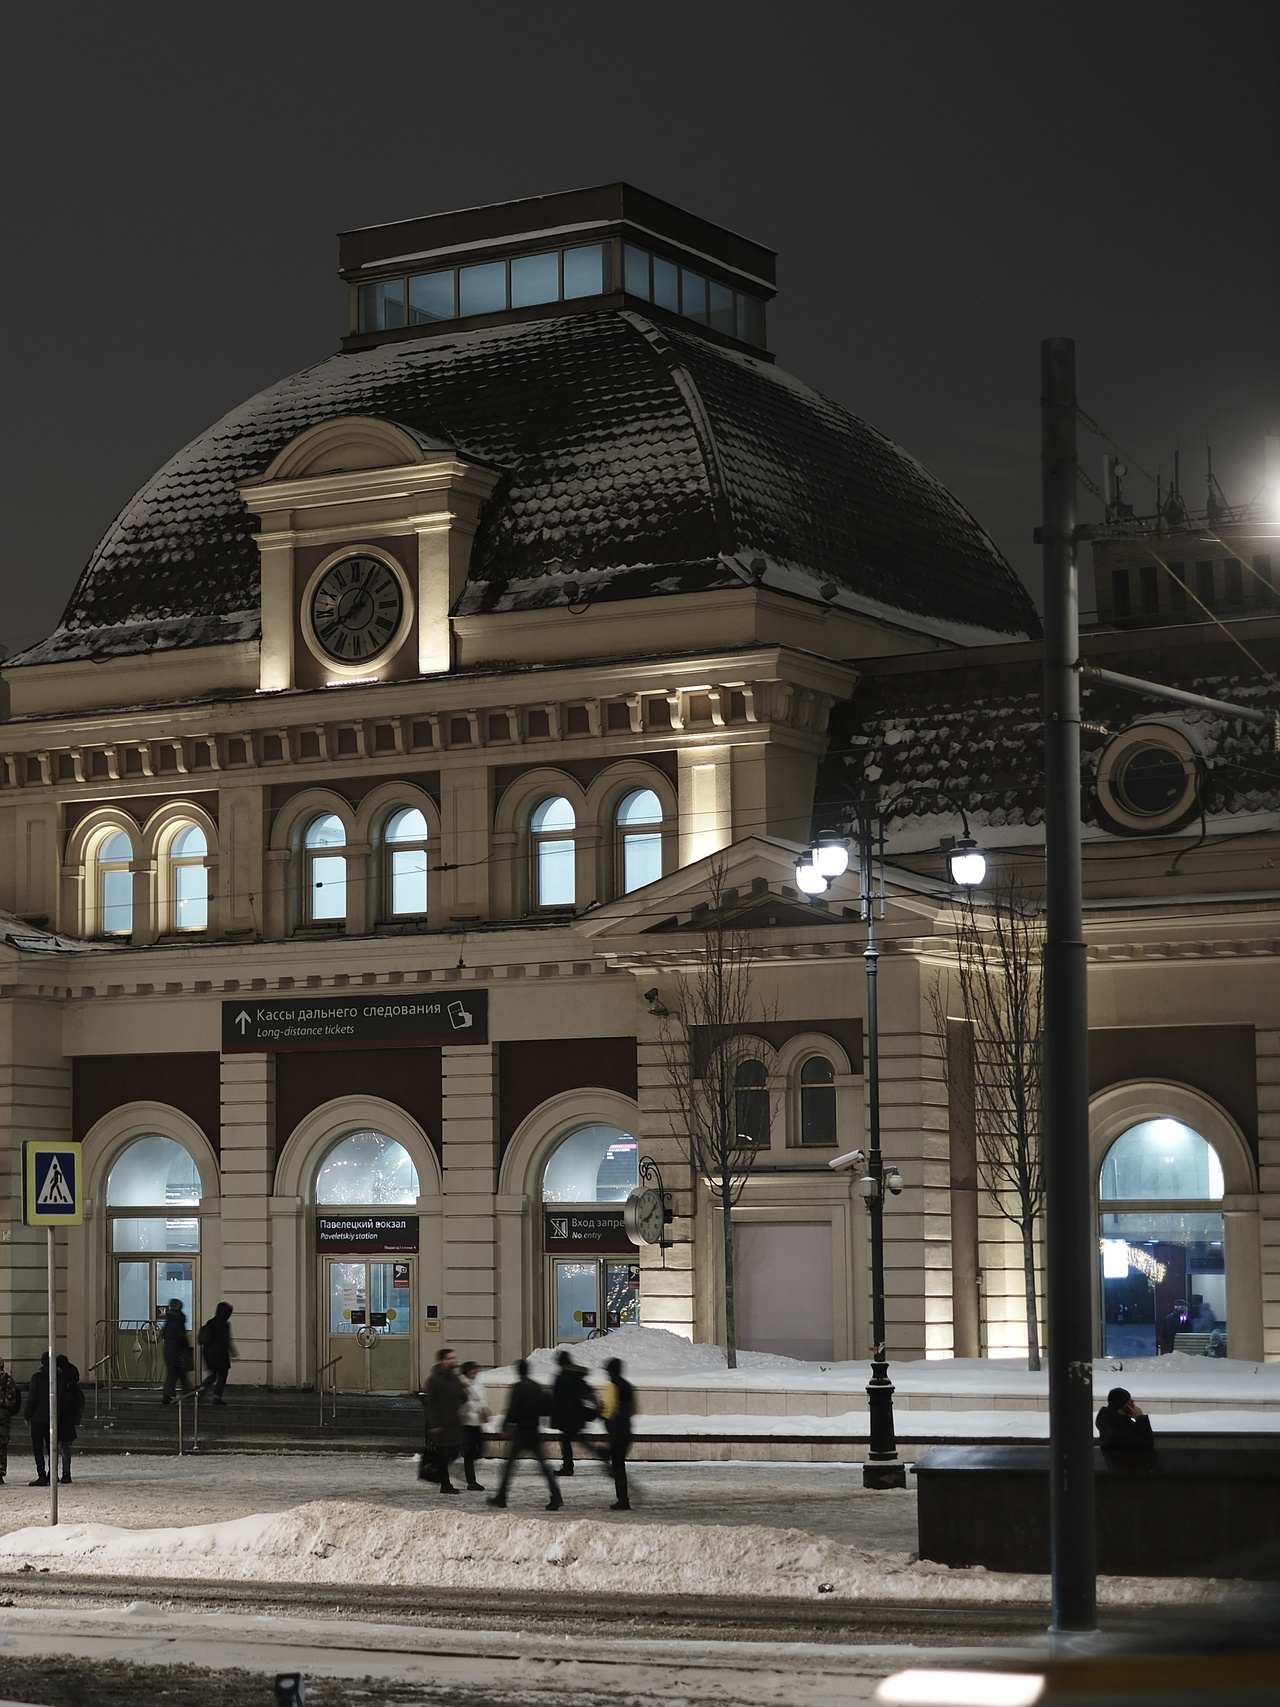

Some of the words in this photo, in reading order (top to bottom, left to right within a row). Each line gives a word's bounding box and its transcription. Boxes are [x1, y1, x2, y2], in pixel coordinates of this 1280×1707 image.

[256, 1008, 295, 1022] Кассы
[297, 1007, 358, 1022] дальнего
[363, 1003, 441, 1018] следования
[256, 1025, 323, 1040] Long-distance
[323, 1024, 355, 1036] tickets
[320, 1219, 374, 1230] Павелецкий
[375, 1220, 407, 1229] вокзал
[571, 1218, 595, 1228] Вход
[320, 1232, 355, 1241] Paveletskiy
[355, 1232, 378, 1240] station
[571, 1231, 583, 1239] No
[583, 1232, 602, 1240] entry
